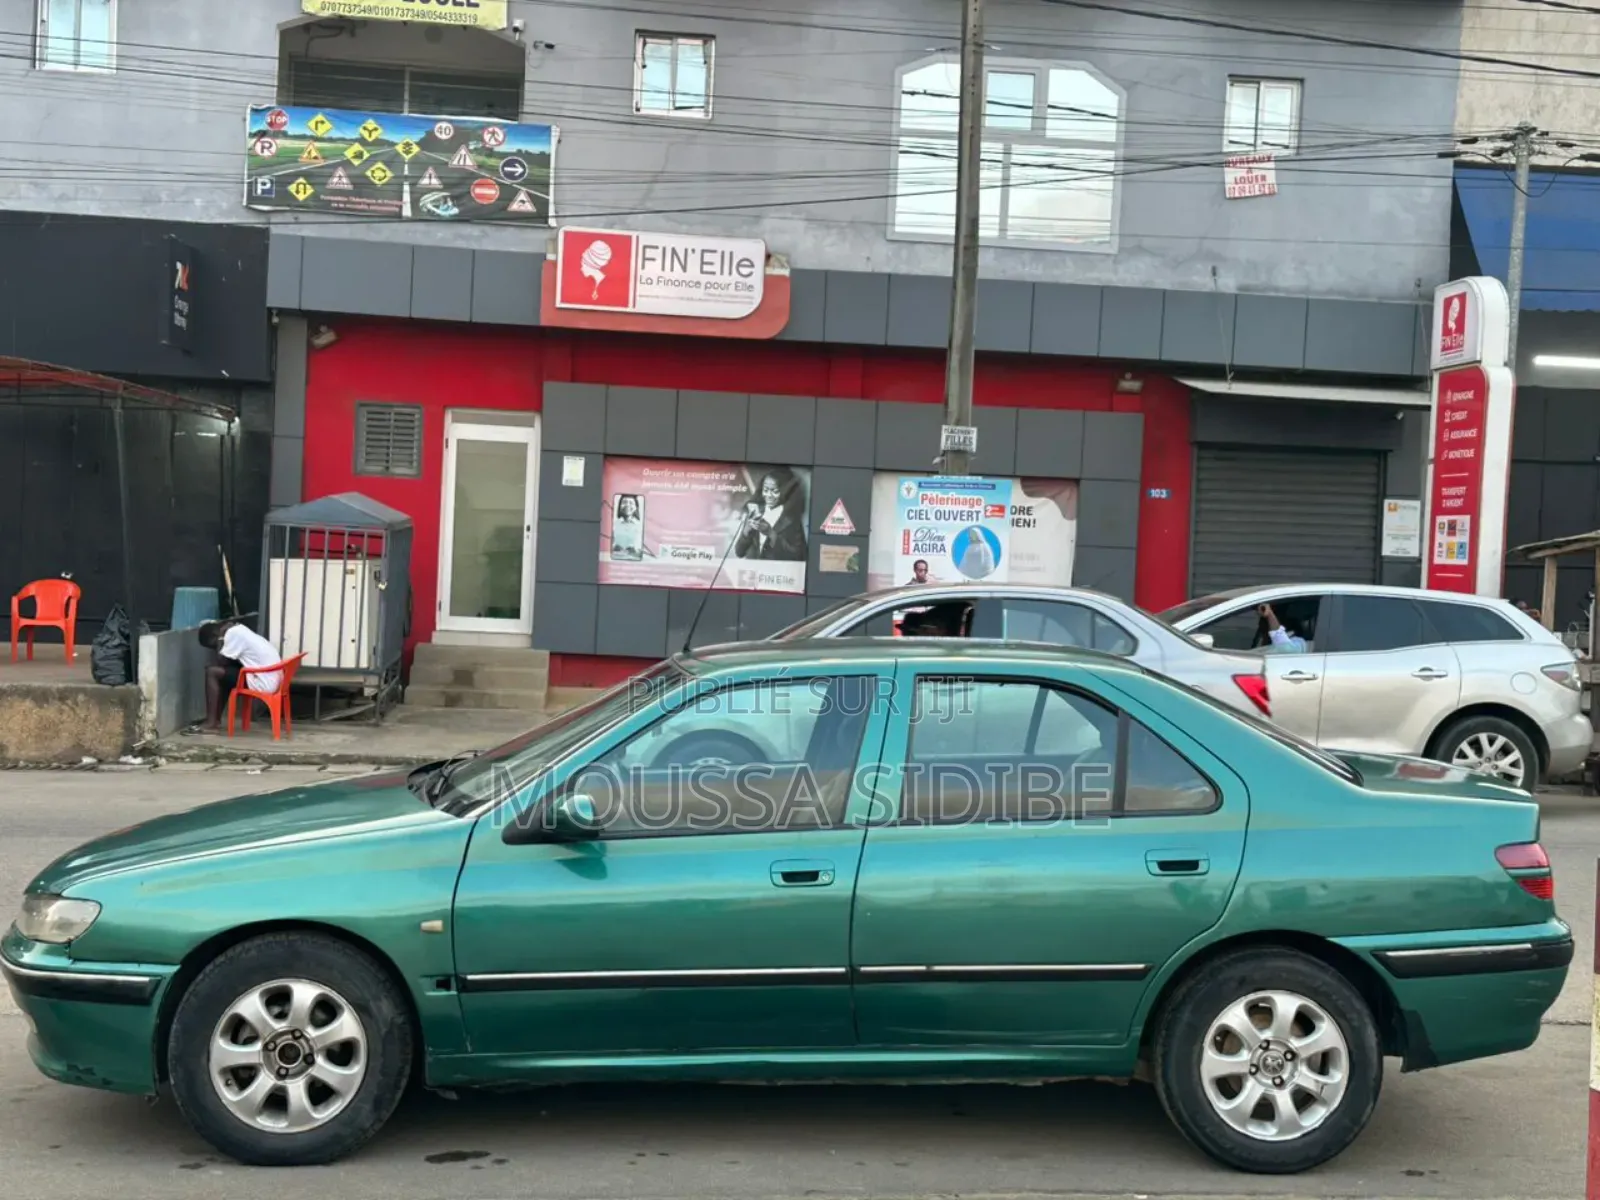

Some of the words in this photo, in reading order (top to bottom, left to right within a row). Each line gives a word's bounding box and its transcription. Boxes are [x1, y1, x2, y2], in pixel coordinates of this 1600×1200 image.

[265, 114, 287, 125] STOP
[436, 124, 451, 136] 40
[257, 178, 271, 196] P
[641, 244, 756, 279] FIN'Elle
[640, 275, 654, 286] La
[657, 276, 701, 289] Finance
[704, 281, 732, 291] pour
[735, 281, 755, 292] Elle
[907, 508, 931, 521] CIEL
[934, 509, 982, 523] OUVERT
[671, 549, 697, 560] Google
[913, 543, 946, 553] AGIRA
